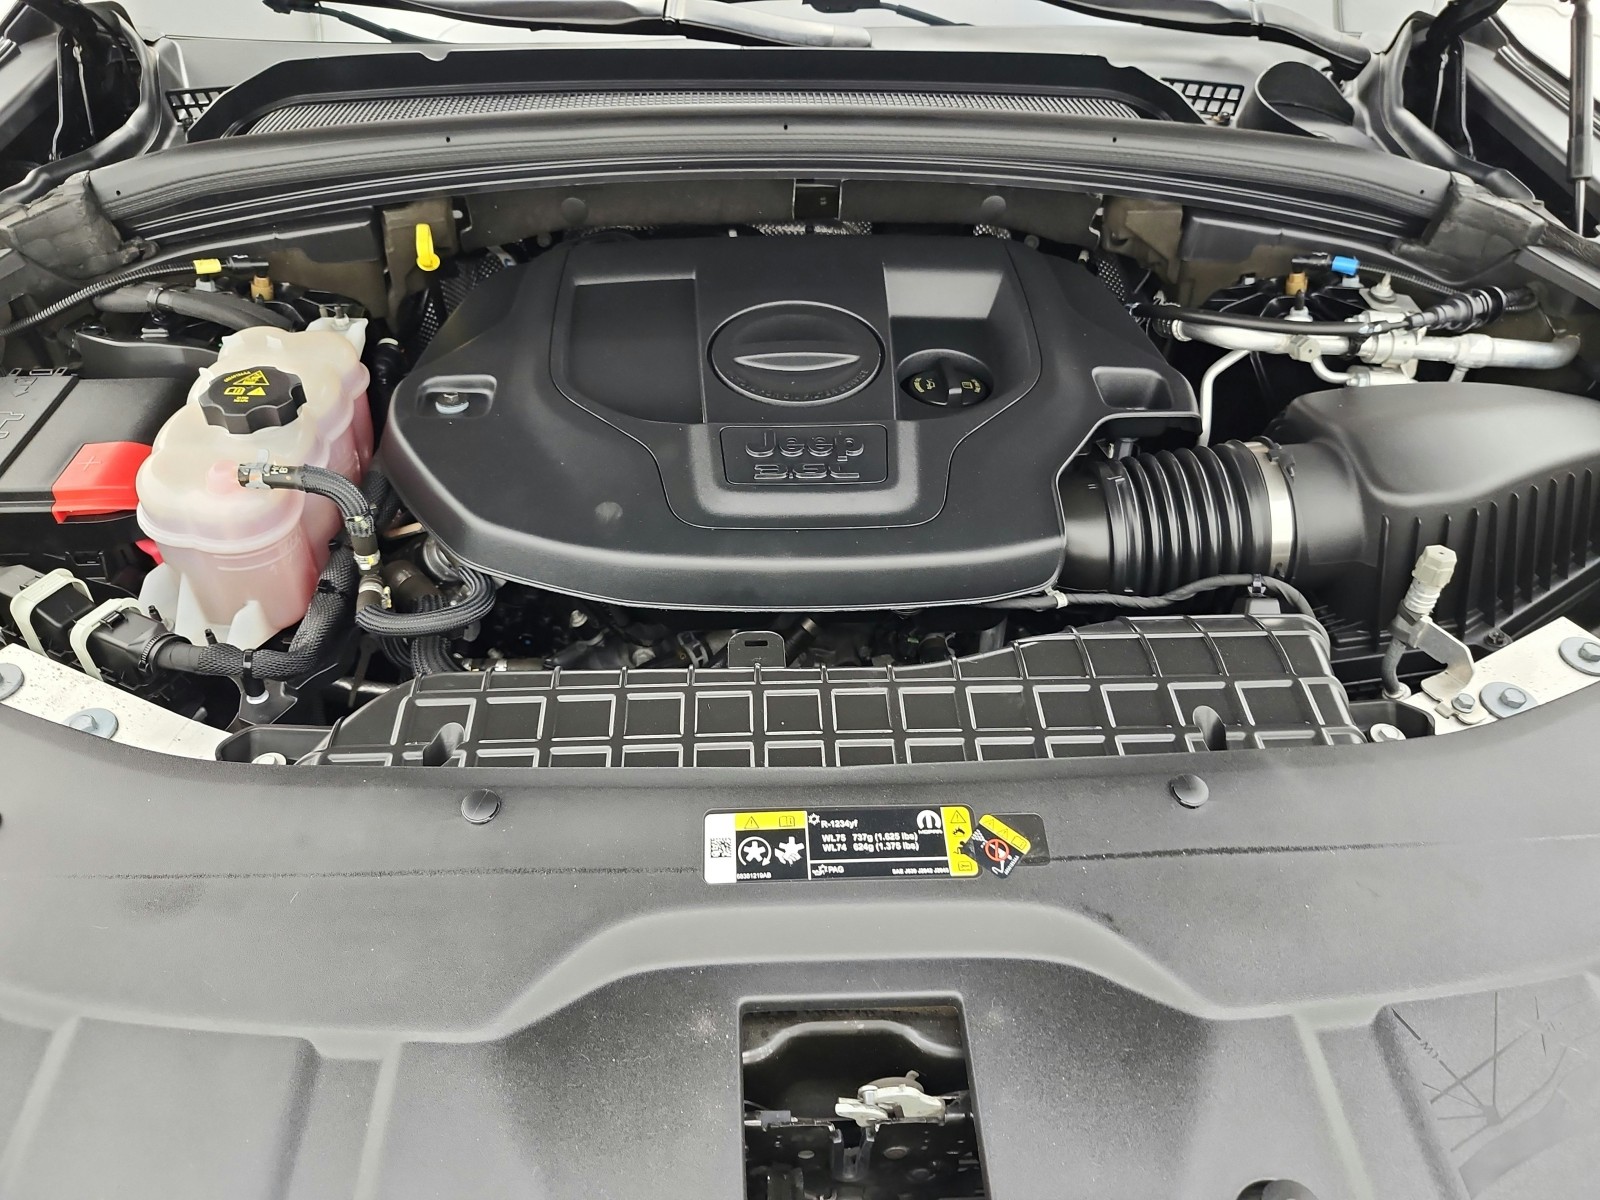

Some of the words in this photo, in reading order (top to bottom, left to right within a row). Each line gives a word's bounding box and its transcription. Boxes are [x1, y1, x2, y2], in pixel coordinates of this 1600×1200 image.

[745, 429, 865, 461] Jeep
[820, 819, 858, 829] R-1234yf
[821, 833, 846, 843] WL75
[852, 833, 874, 843] 737g
[874, 832, 900, 842] (1.625
[901, 831, 918, 841] lbs)
[822, 843, 847, 852] WL74
[853, 842, 874, 852] 624g
[875, 842, 901, 852] (1.375
[902, 841, 919, 852] lbs)
[828, 865, 845, 874] PAG
